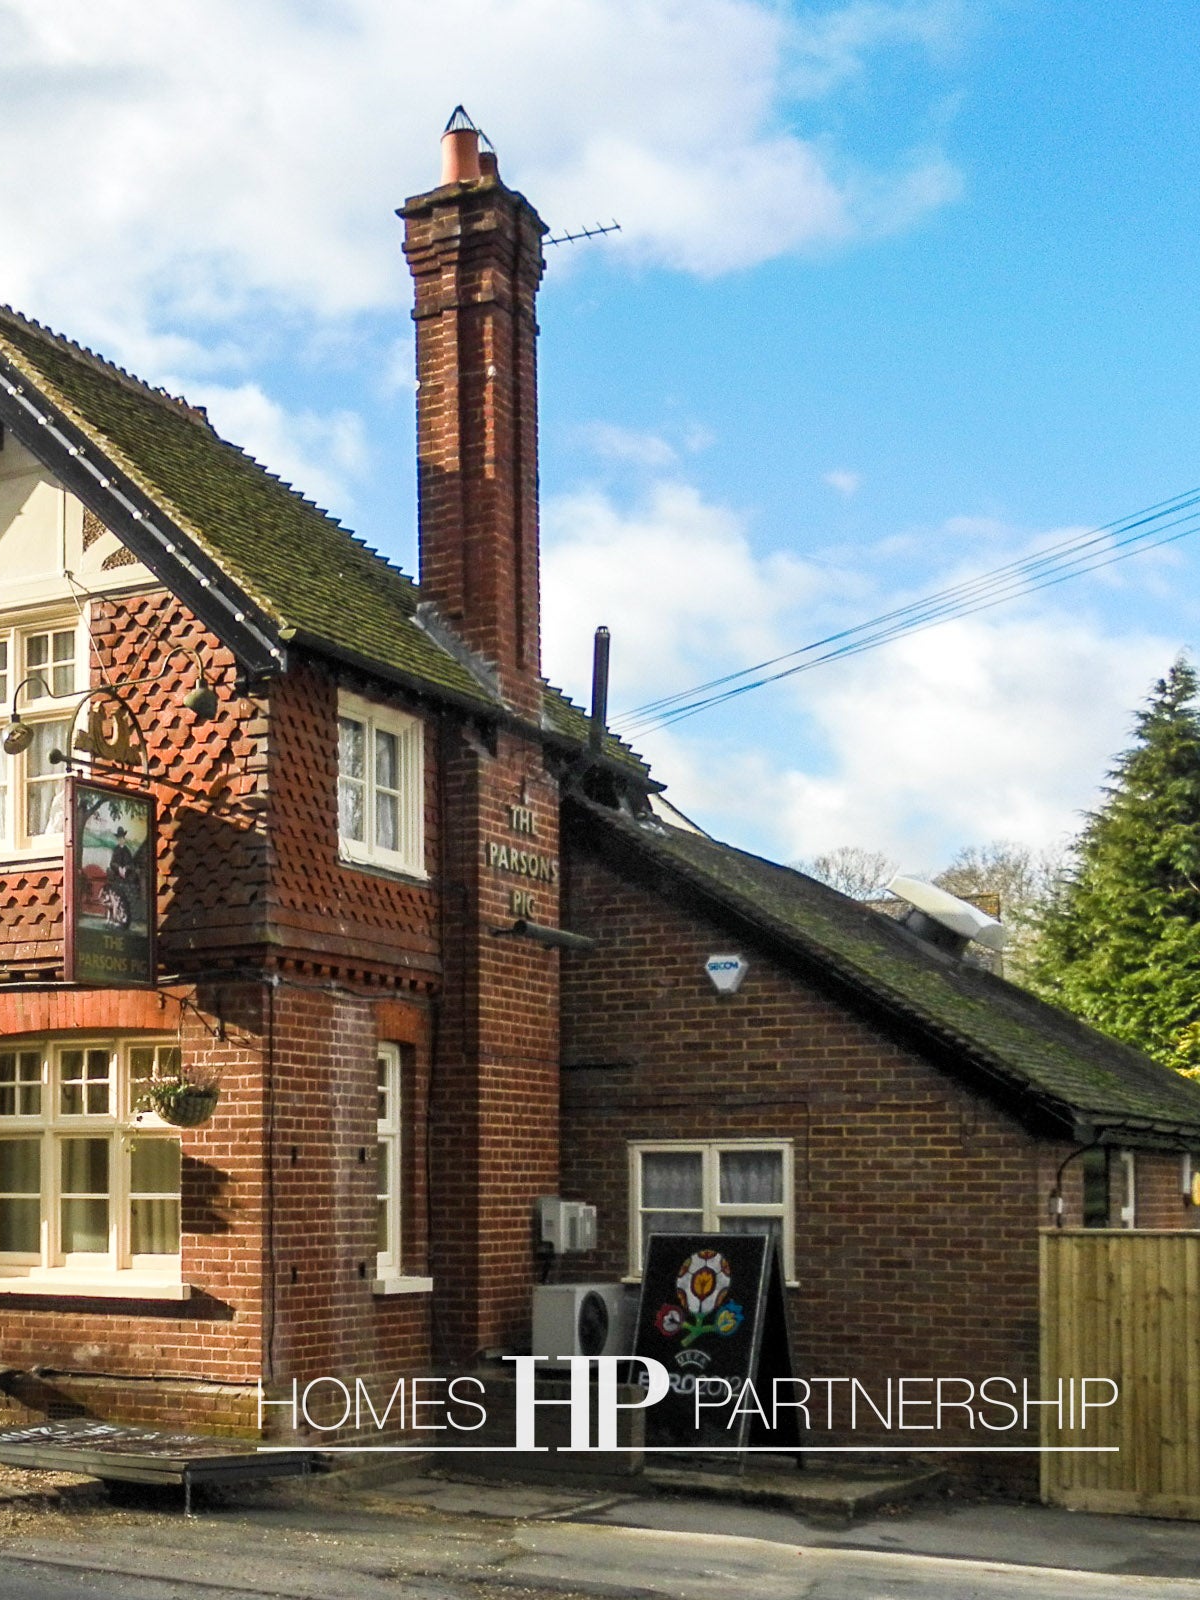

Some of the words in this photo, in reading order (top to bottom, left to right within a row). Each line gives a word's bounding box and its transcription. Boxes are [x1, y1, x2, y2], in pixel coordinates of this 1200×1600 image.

[511, 805, 537, 835] THE
[490, 842, 558, 881] PARSONS
[103, 935, 124, 952] THE
[78, 952, 127, 972] PARSONS
